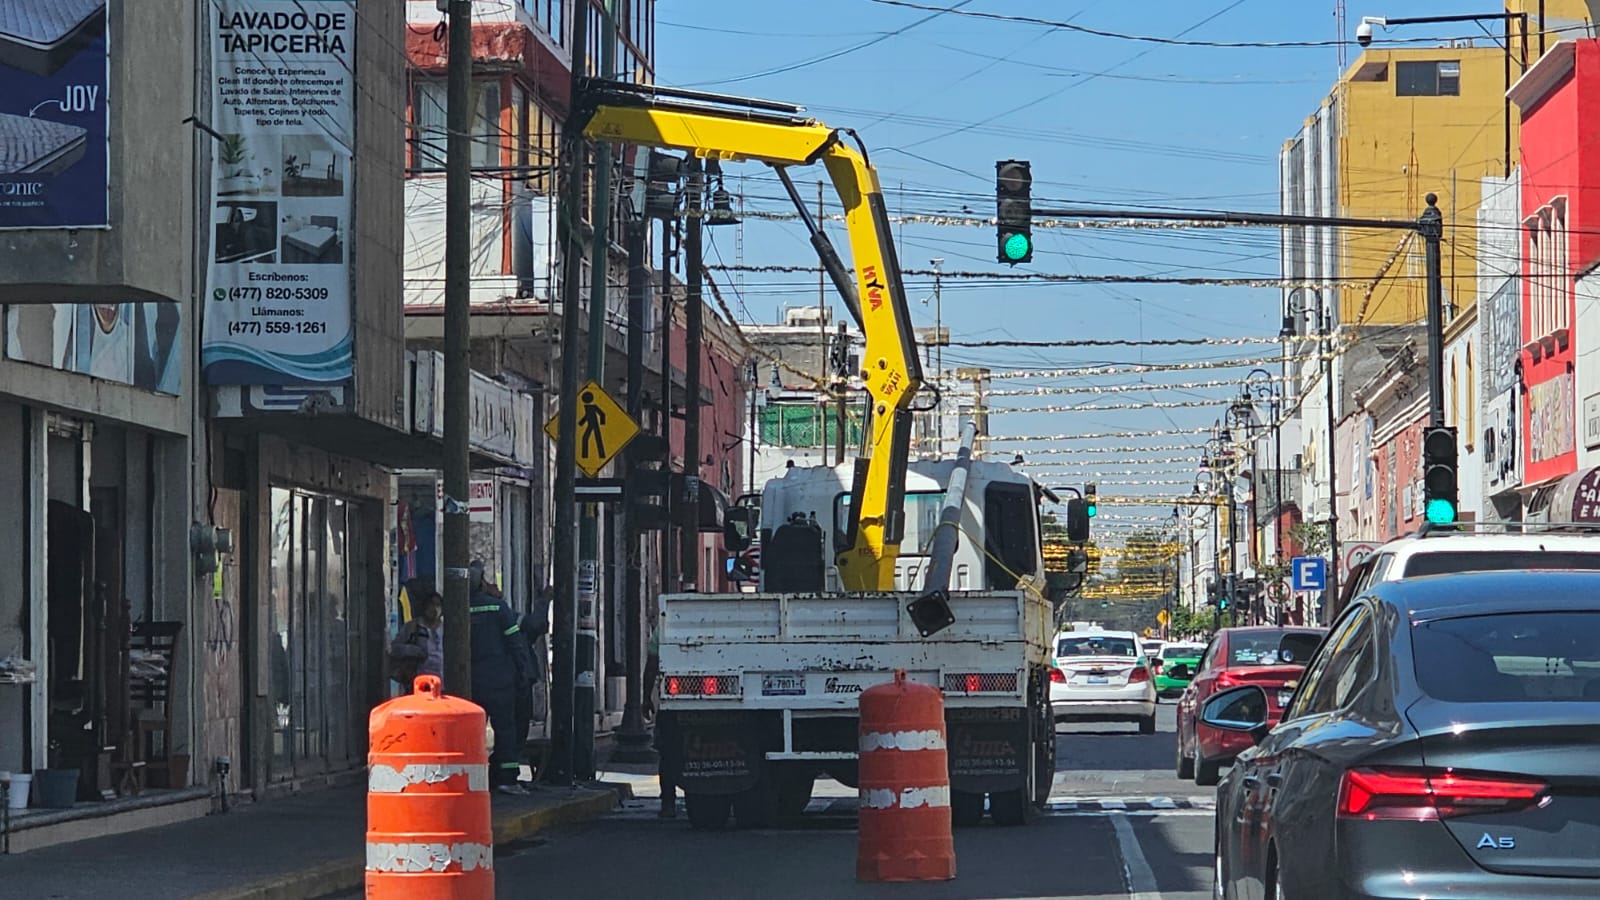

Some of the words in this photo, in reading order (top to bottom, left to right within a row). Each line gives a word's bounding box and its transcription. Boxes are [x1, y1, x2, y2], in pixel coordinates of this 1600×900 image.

[219, 12, 308, 30] LAVADO
[316, 13, 346, 30] DE
[219, 29, 346, 53] TAPICERÍA
[235, 67, 266, 75] Conoce
[268, 67, 277, 76] la
[278, 68, 326, 77] Experiencia
[252, 77, 279, 85] donde
[290, 77, 334, 86] ofrecemos
[336, 77, 344, 85] el
[60, 85, 98, 111] JOY
[220, 87, 249, 95] Lavado
[251, 87, 261, 95] de
[290, 88, 329, 96] Interiores
[269, 107, 299, 117] Cojines
[256, 118, 272, 127] tipo
[273, 118, 284, 126] de
[248, 271, 308, 282] Escríbenos:
[228, 287, 262, 302] (477)
[862, 265, 885, 312] HYVA
[251, 307, 304, 316] Llámanos:
[228, 321, 261, 336] (477)
[1301, 562, 1319, 587] E
[1477, 832, 1515, 849] A5
